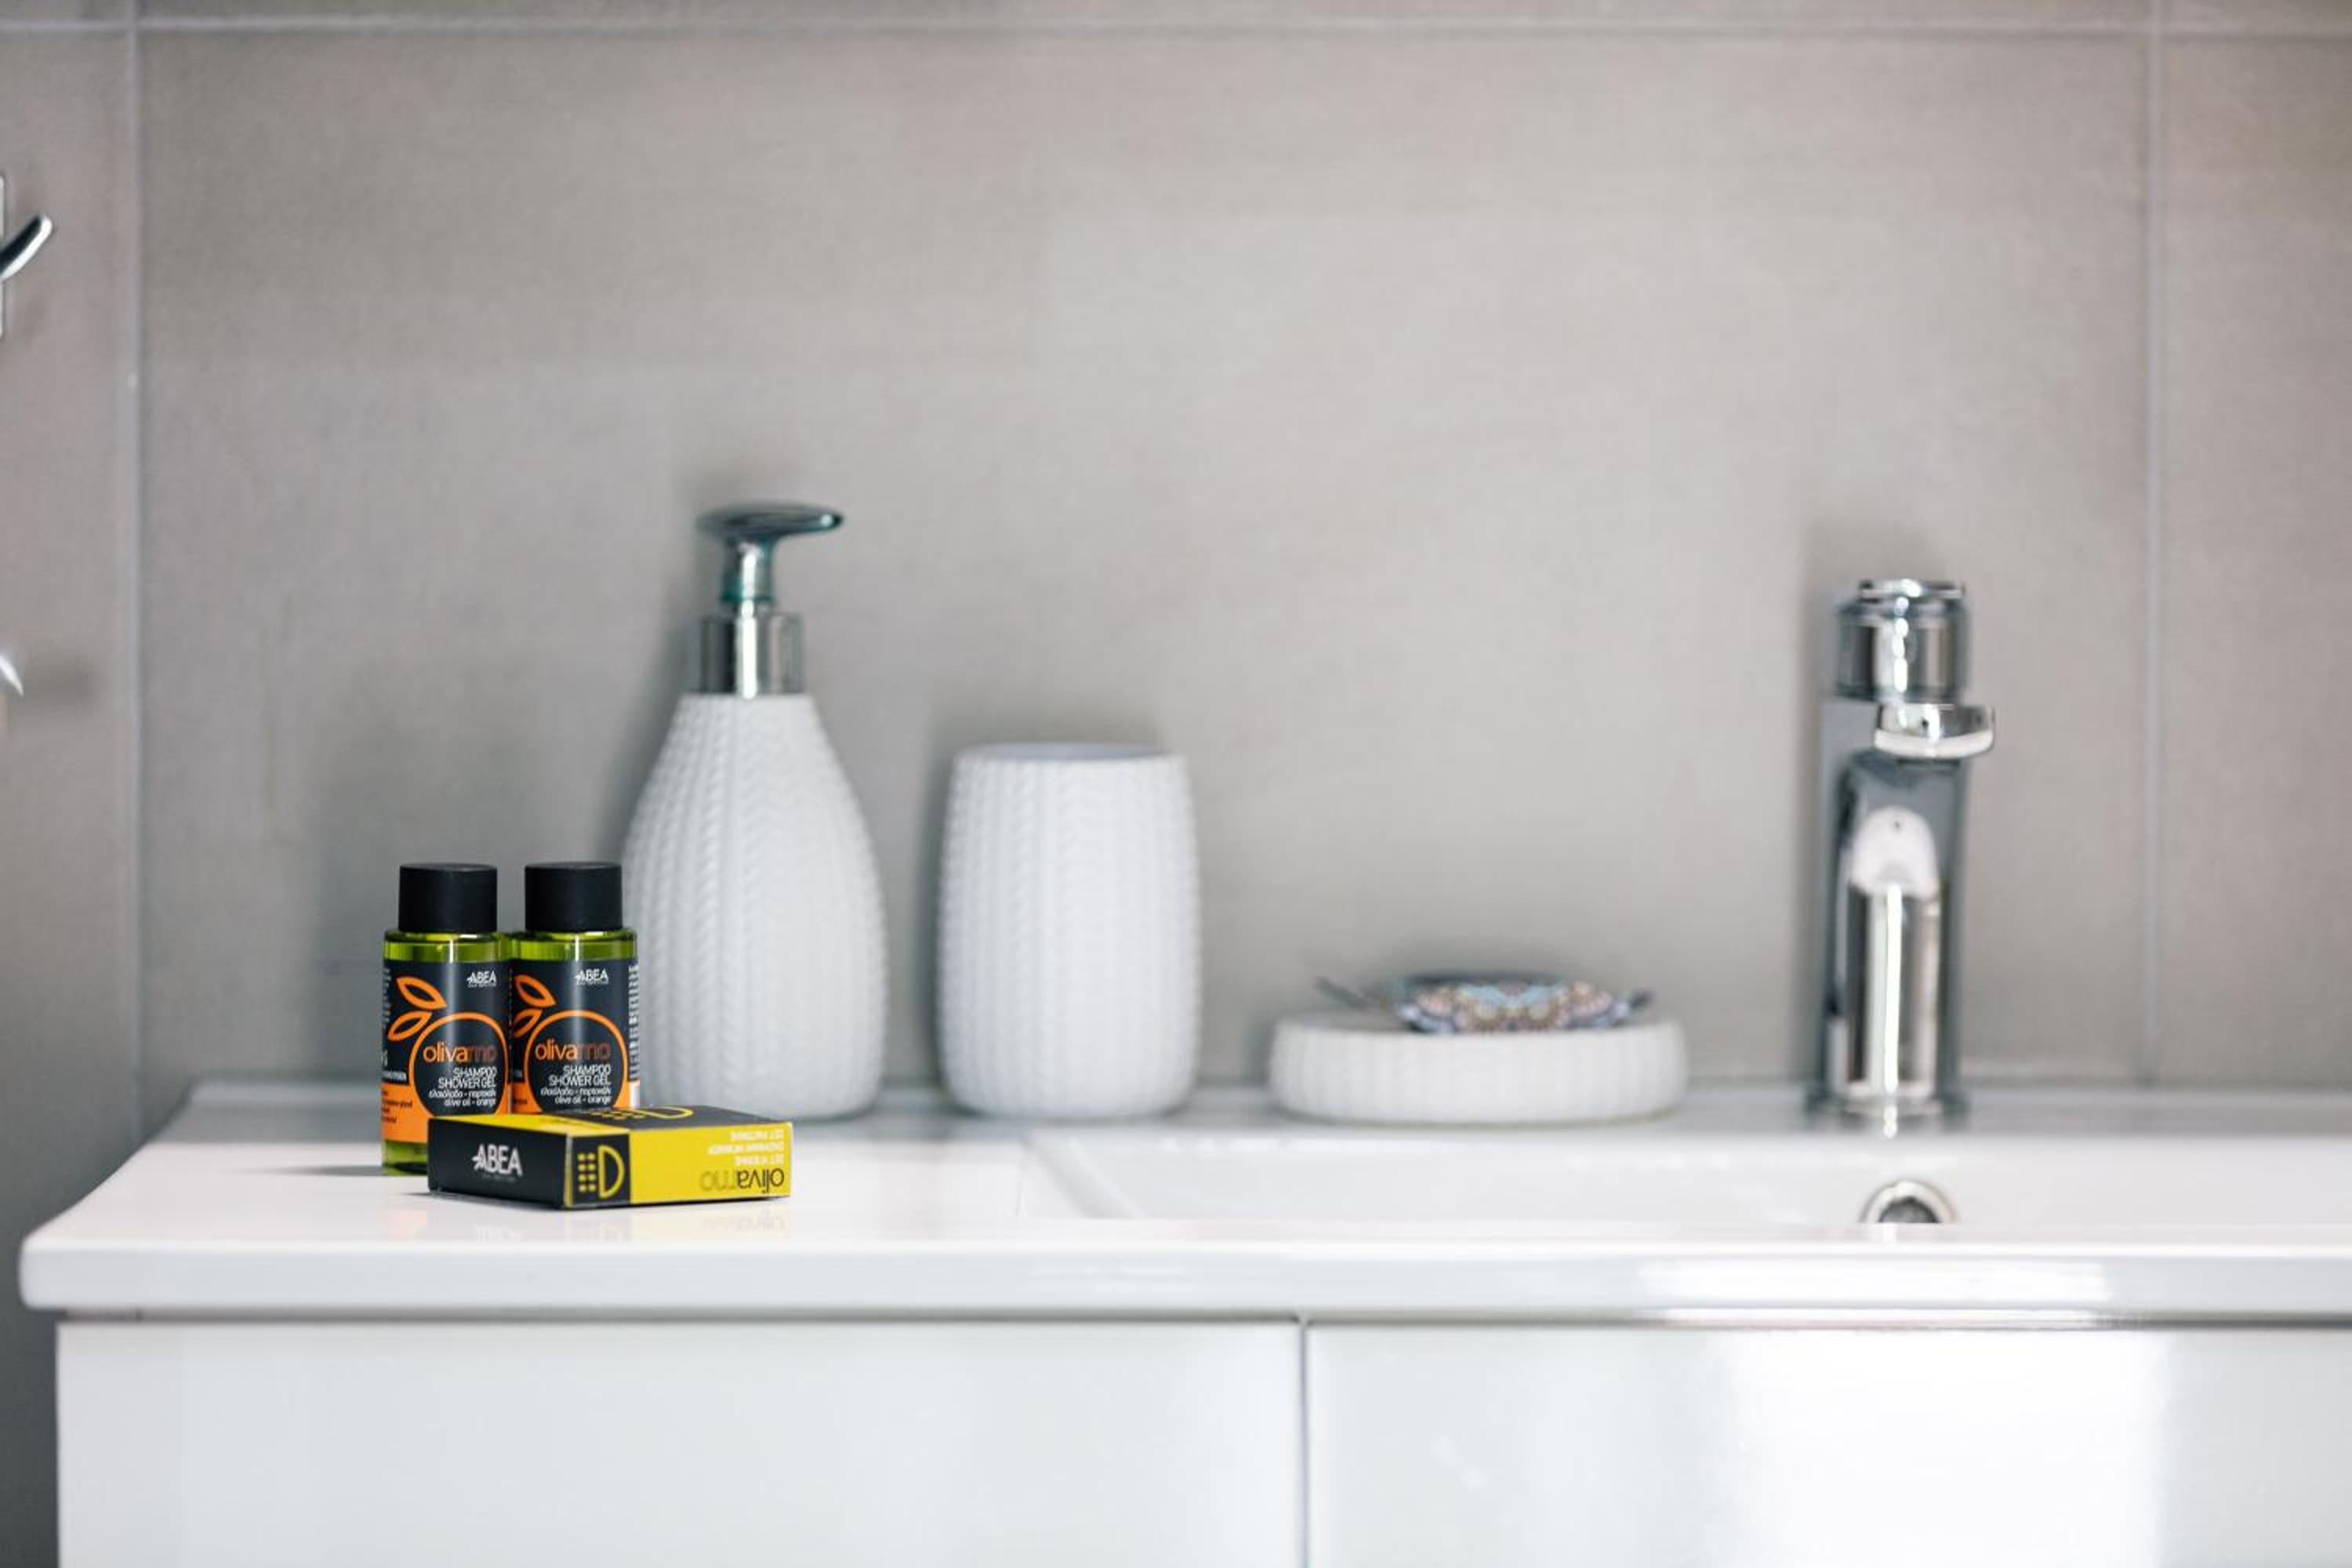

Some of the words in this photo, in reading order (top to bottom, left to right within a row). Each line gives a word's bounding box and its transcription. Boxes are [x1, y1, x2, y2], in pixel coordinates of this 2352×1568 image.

[466, 970, 496, 983] ABEA
[575, 967, 609, 981] ABEA
[452, 1065, 498, 1077] SHAMPOO
[563, 1064, 612, 1076] SHAMPOO
[438, 1077, 480, 1089] SHOWER
[481, 1076, 497, 1088] GEL
[549, 1074, 593, 1087] SHOWER
[593, 1074, 612, 1086] GEL
[471, 1144, 523, 1176] ABEA
